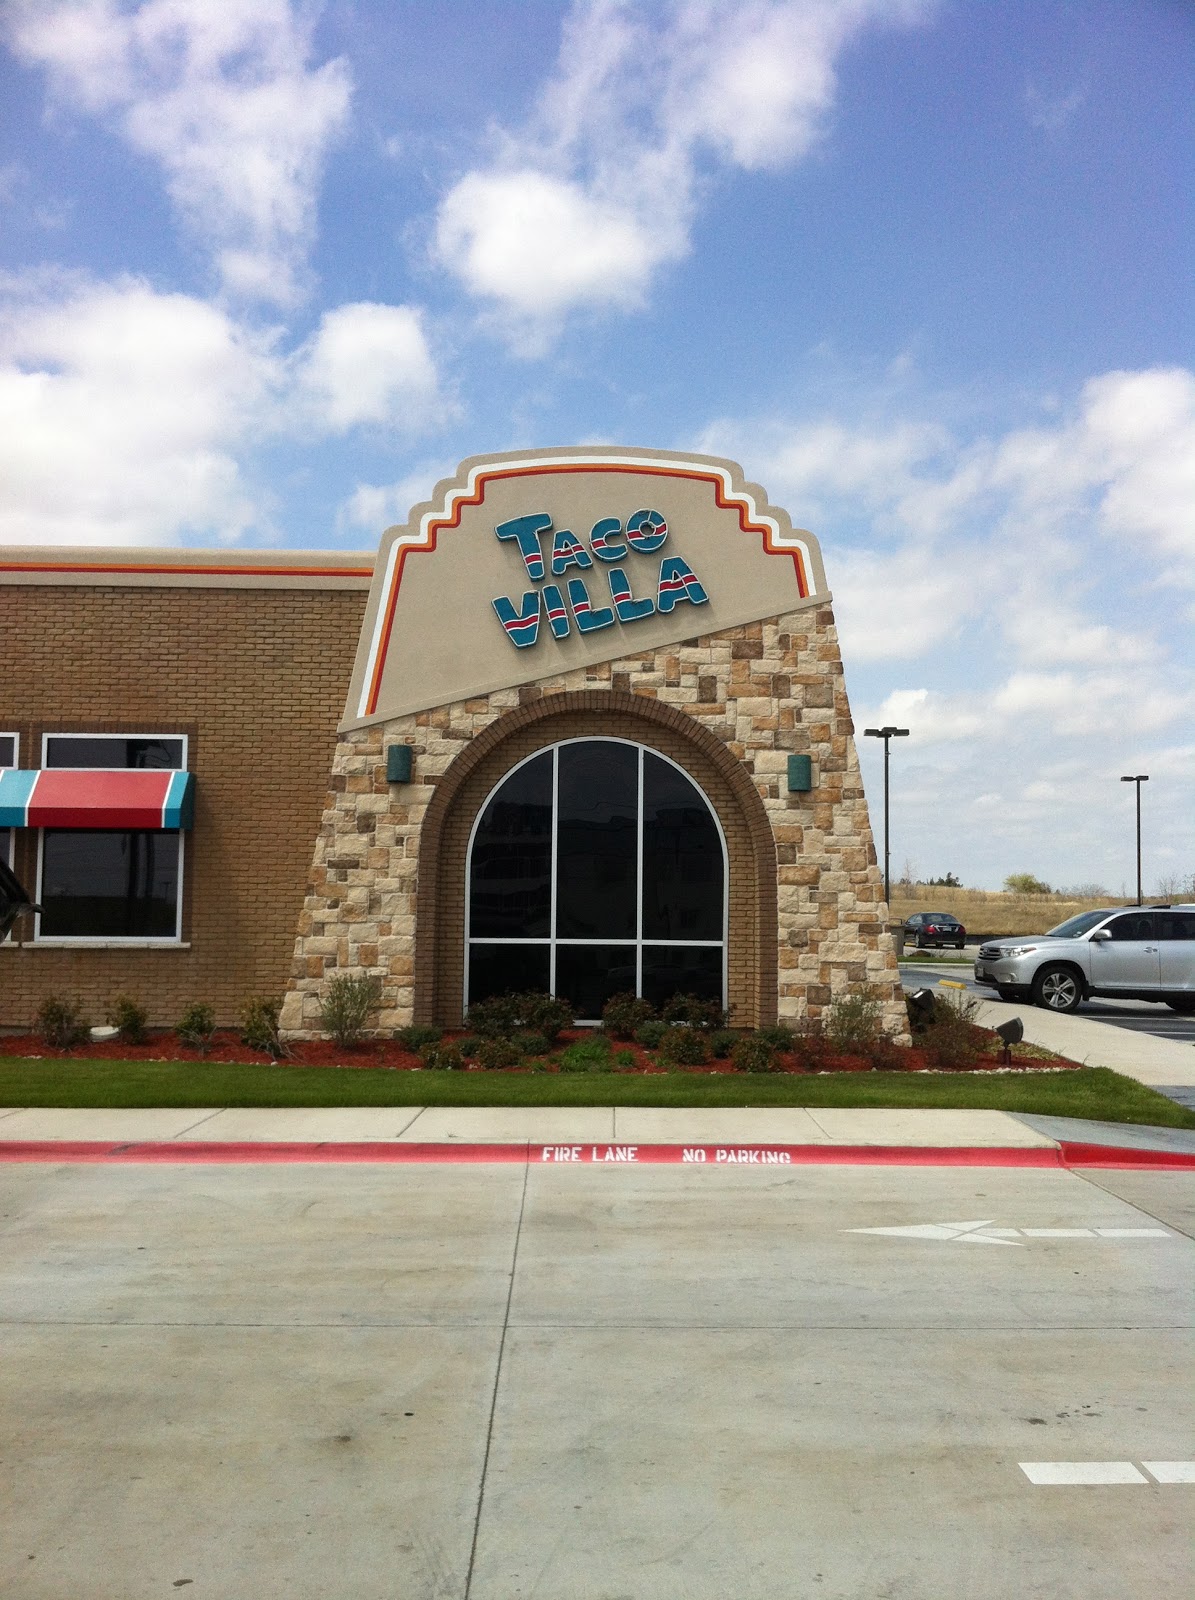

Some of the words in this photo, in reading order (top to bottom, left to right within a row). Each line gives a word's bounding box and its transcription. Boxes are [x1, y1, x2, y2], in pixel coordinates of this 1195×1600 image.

[494, 508, 669, 582] TACO
[491, 556, 710, 650] VILLA
[541, 1146, 583, 1162] FIRE
[591, 1146, 640, 1162] LANE
[682, 1148, 707, 1163] NO
[715, 1149, 792, 1164] PARKING
